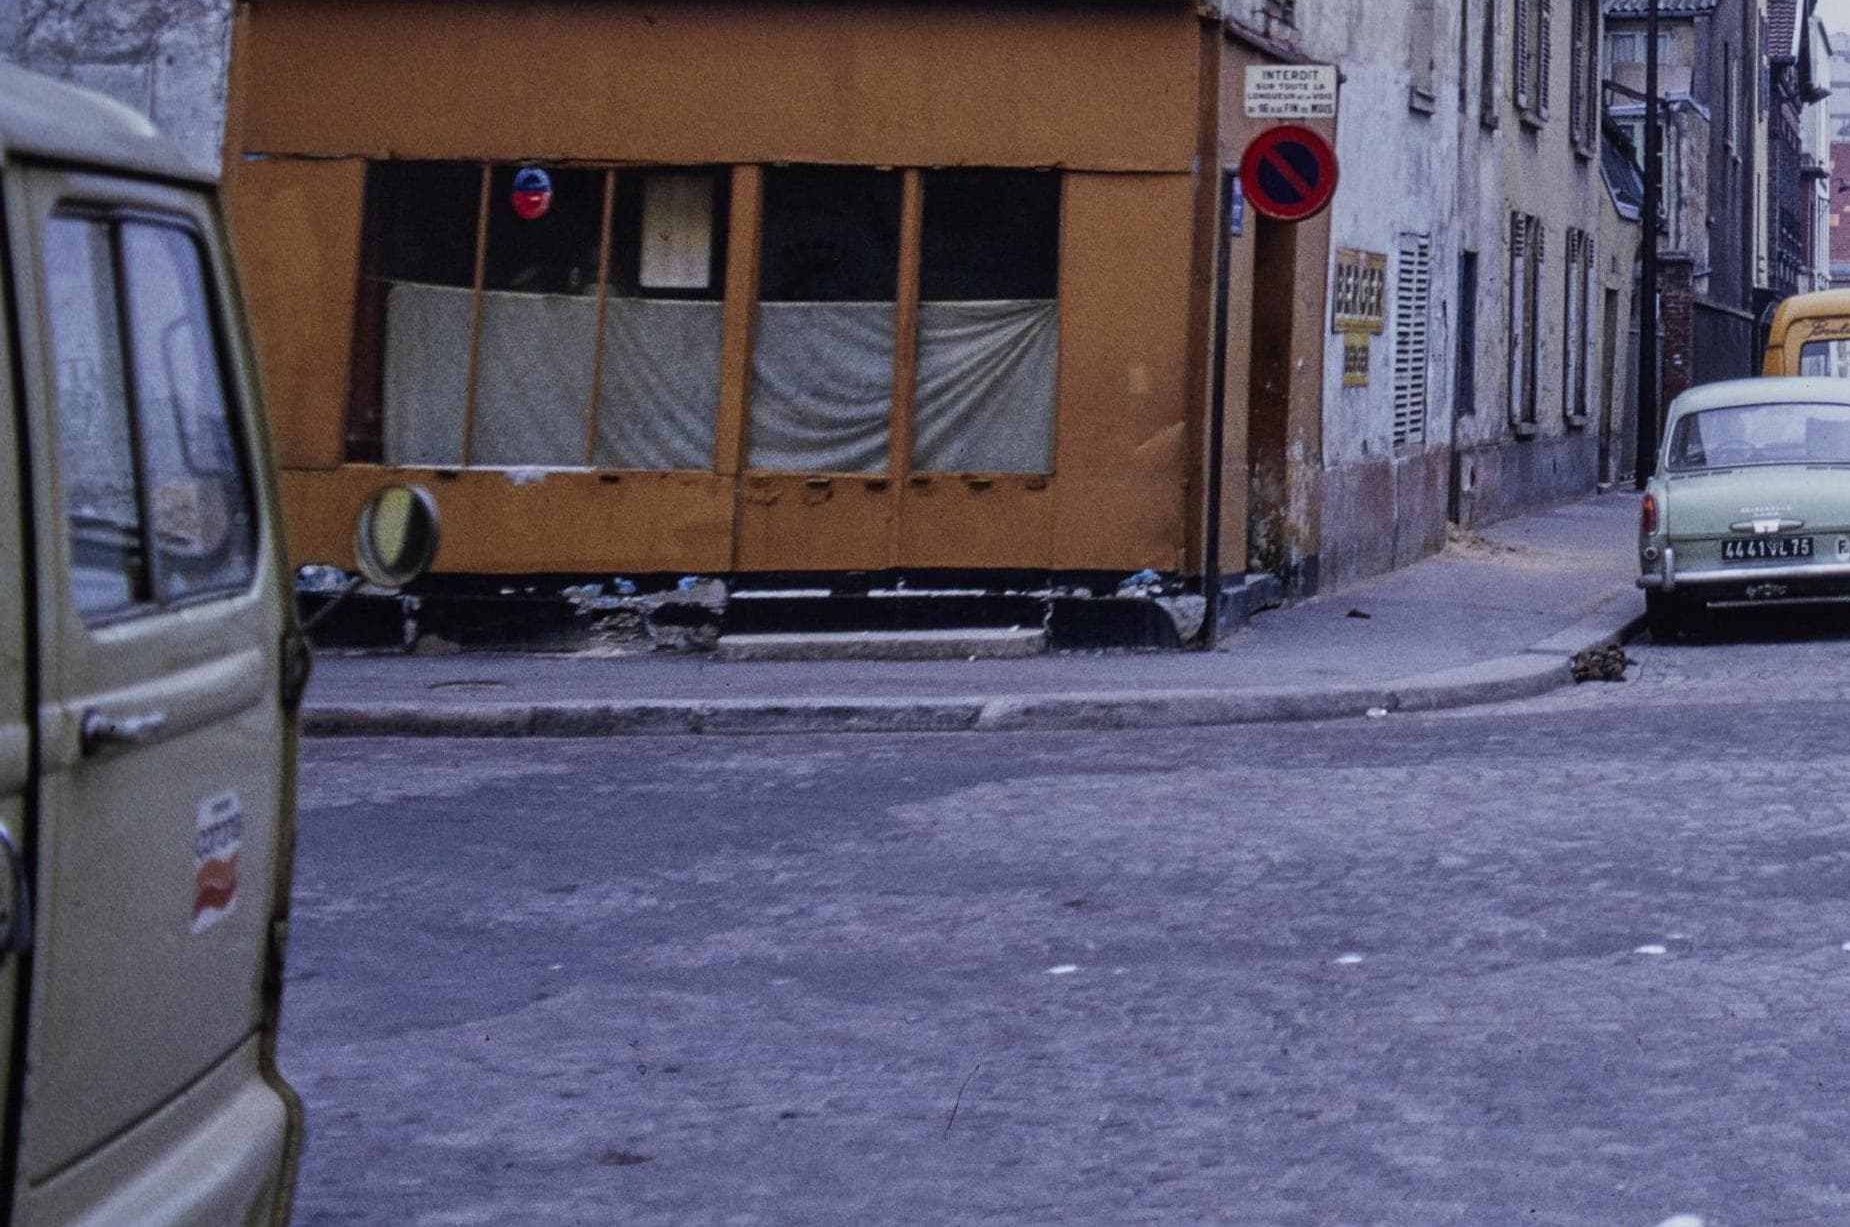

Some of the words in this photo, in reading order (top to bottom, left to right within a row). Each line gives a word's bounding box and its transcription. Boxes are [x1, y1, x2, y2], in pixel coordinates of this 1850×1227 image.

[1261, 69, 1319, 82] INTERDIT
[1279, 82, 1308, 91] TOUTE
[1725, 539, 1766, 559] 4441
[1791, 537, 1810, 556] 75
